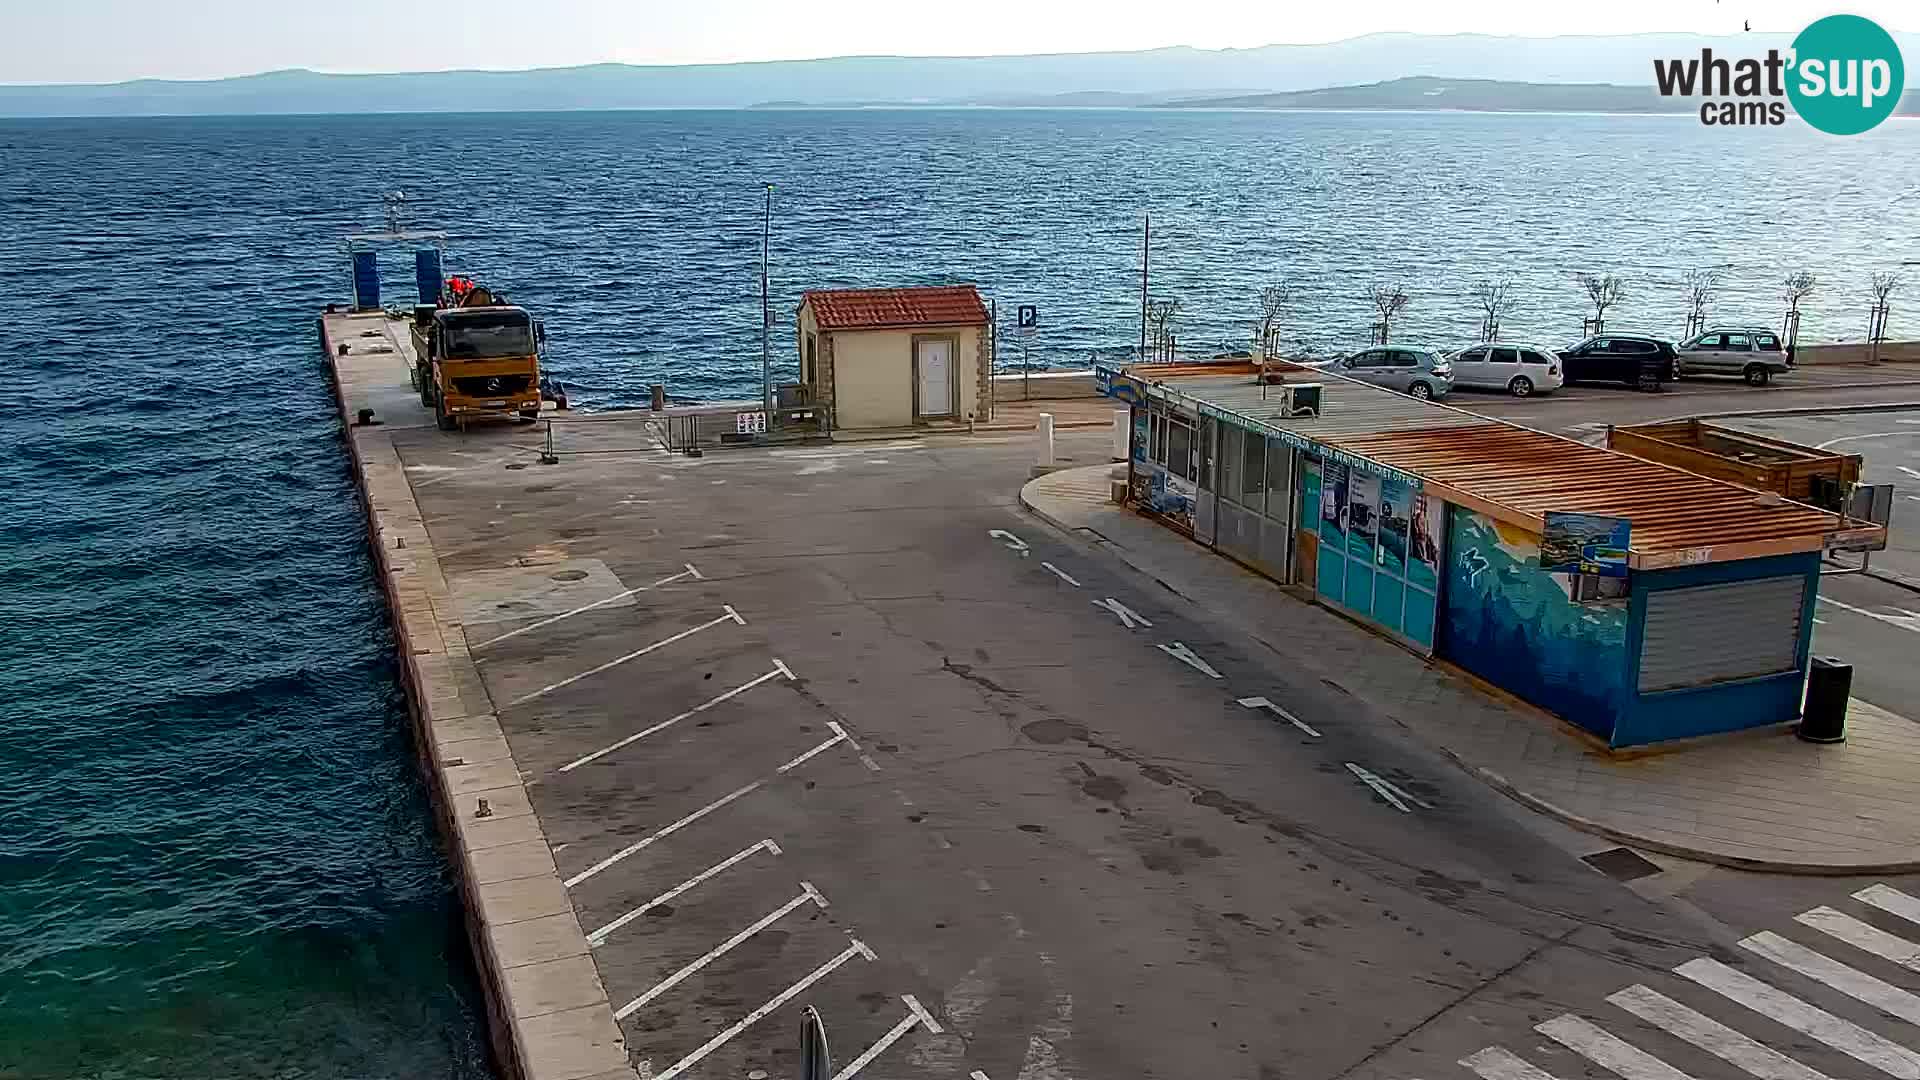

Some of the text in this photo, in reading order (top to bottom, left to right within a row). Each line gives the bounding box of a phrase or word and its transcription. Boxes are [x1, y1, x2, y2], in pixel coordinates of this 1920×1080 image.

[1022, 308, 1032, 325] P
[1335, 451, 1365, 470] STATION
[1367, 462, 1392, 480] TICKET
[1392, 471, 1419, 488] OFFICE
